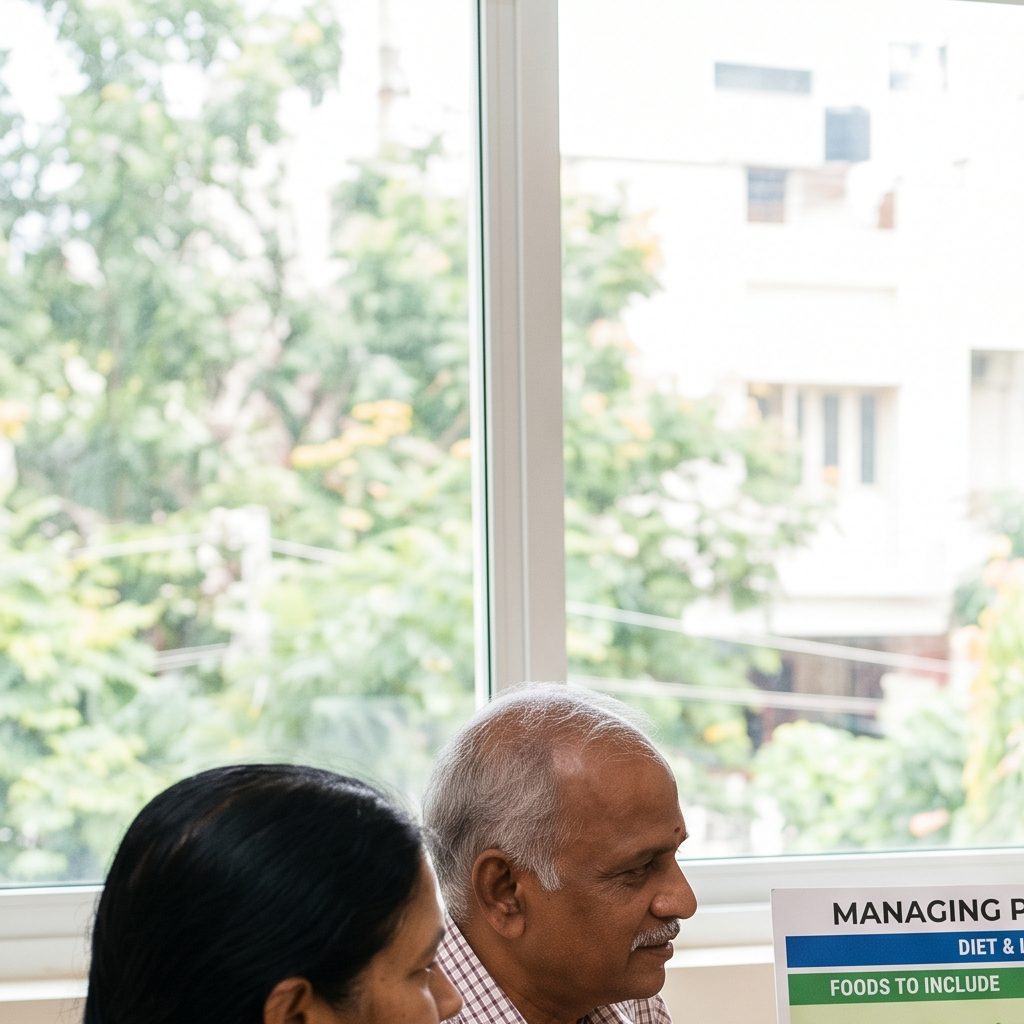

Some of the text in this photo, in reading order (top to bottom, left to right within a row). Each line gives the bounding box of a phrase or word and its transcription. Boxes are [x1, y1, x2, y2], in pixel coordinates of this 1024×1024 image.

[832, 898, 1001, 926] MANAGING
[958, 937, 998, 956] DIET
[1002, 937, 1015, 955] &
[830, 974, 1001, 997] FOODS TO INCLUDE
